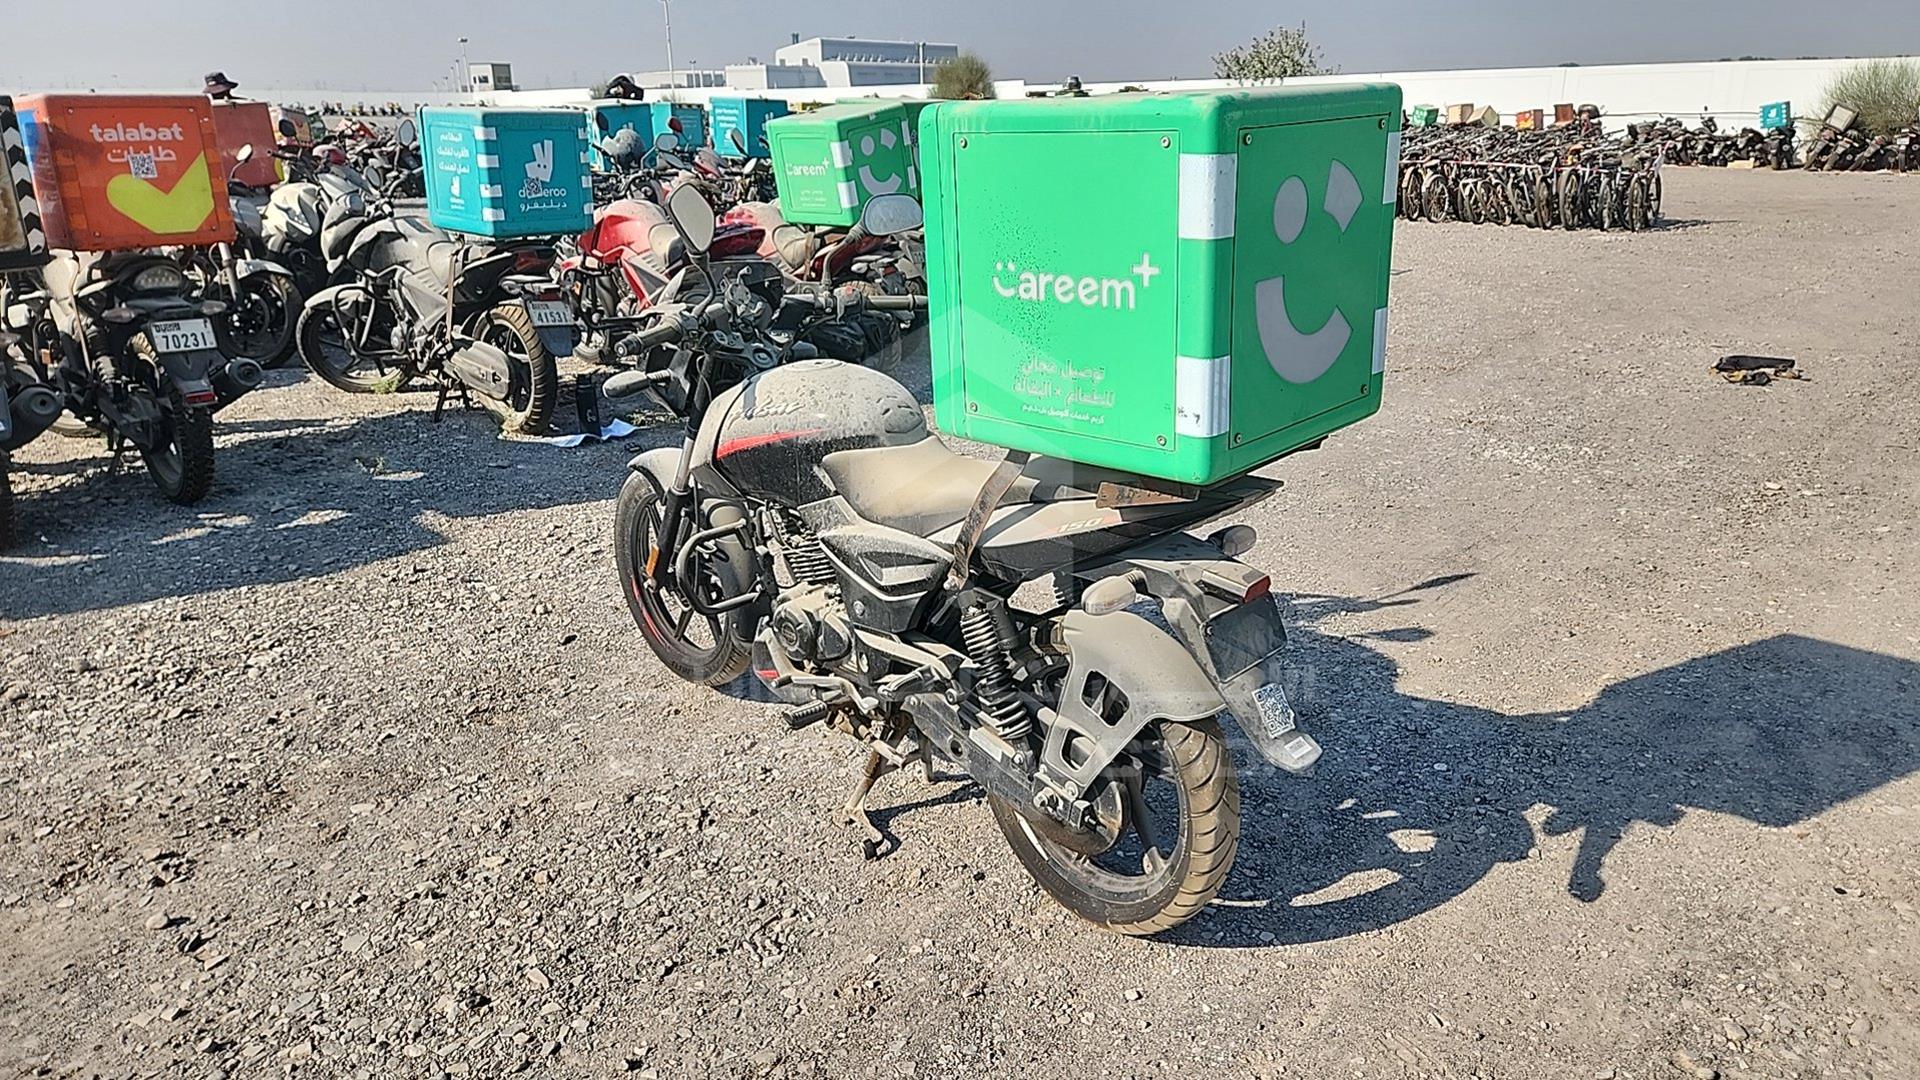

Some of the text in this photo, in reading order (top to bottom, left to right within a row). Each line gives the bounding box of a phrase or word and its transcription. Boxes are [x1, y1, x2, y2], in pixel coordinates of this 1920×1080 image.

[89, 122, 184, 143] talabat
[518, 186, 567, 198] deroo
[161, 331, 207, 350] 70231
[1058, 517, 1103, 532] 150
